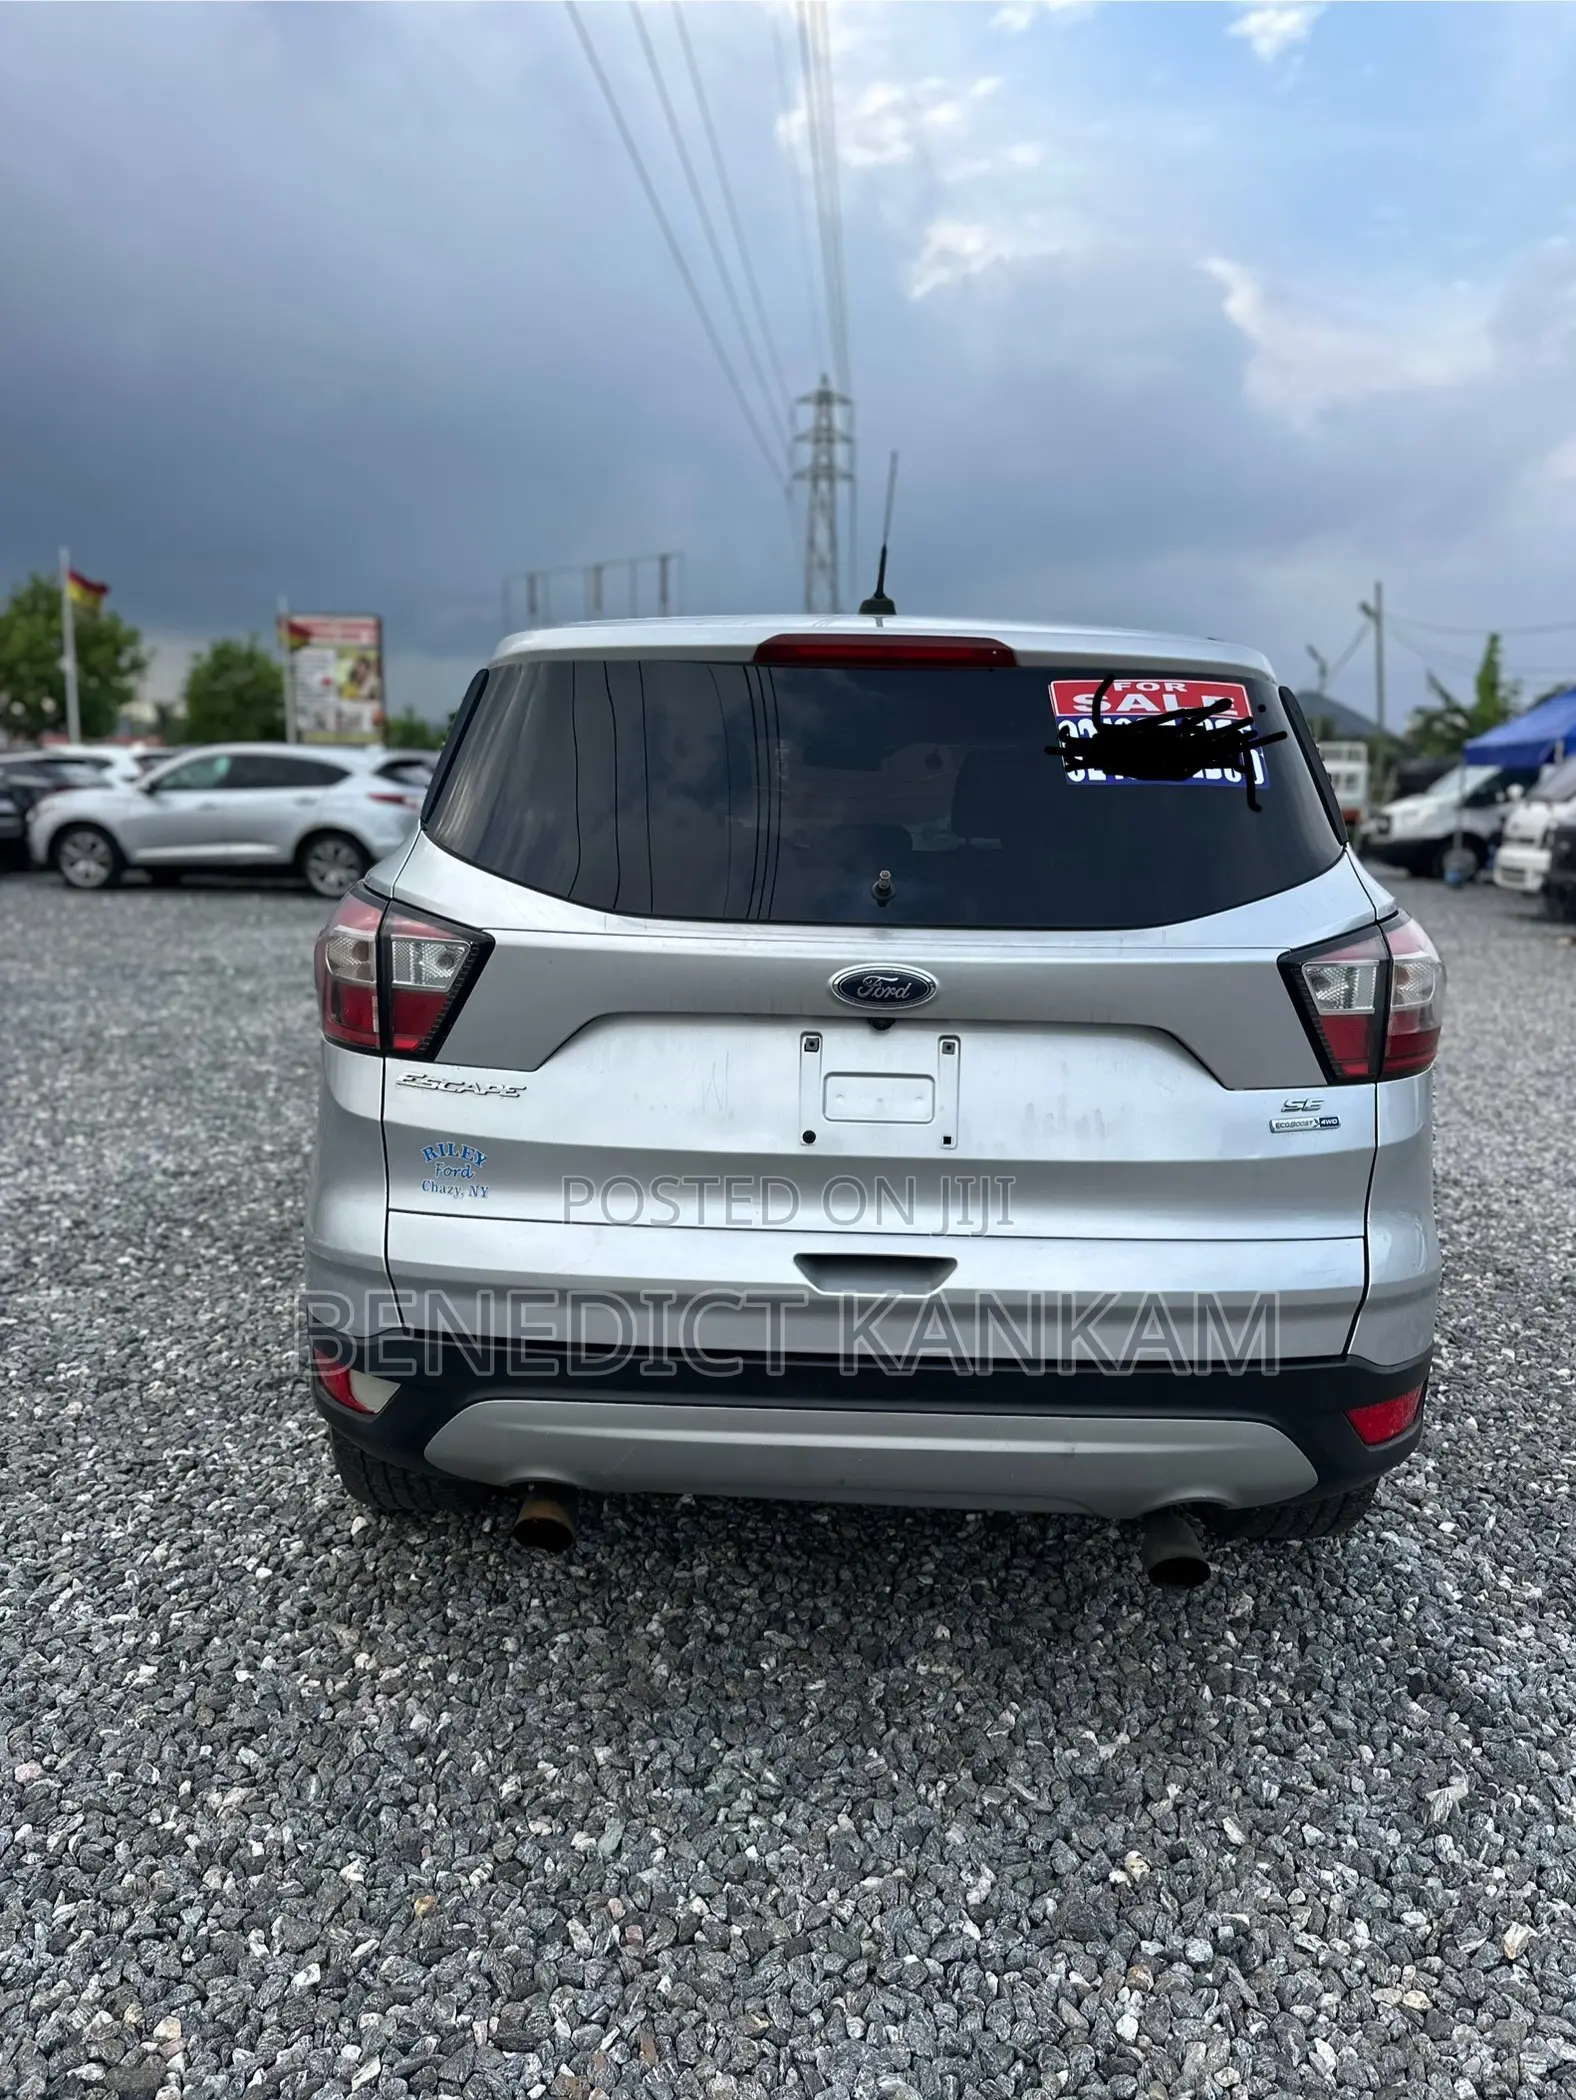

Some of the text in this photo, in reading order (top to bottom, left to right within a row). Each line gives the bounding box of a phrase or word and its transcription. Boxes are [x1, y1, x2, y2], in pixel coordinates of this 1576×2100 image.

[1113, 682, 1188, 693] FOR
[1072, 693, 1239, 715] SALE
[857, 975, 912, 999] Ford
[396, 1071, 527, 1098] ESCAPE
[1281, 1099, 1324, 1112] SE
[1275, 1117, 1339, 1129] ECOBOOST 4WD
[421, 1142, 487, 1168] RILEY
[435, 1162, 475, 1180] Ford
[421, 1179, 490, 1199] Chazy, NY
